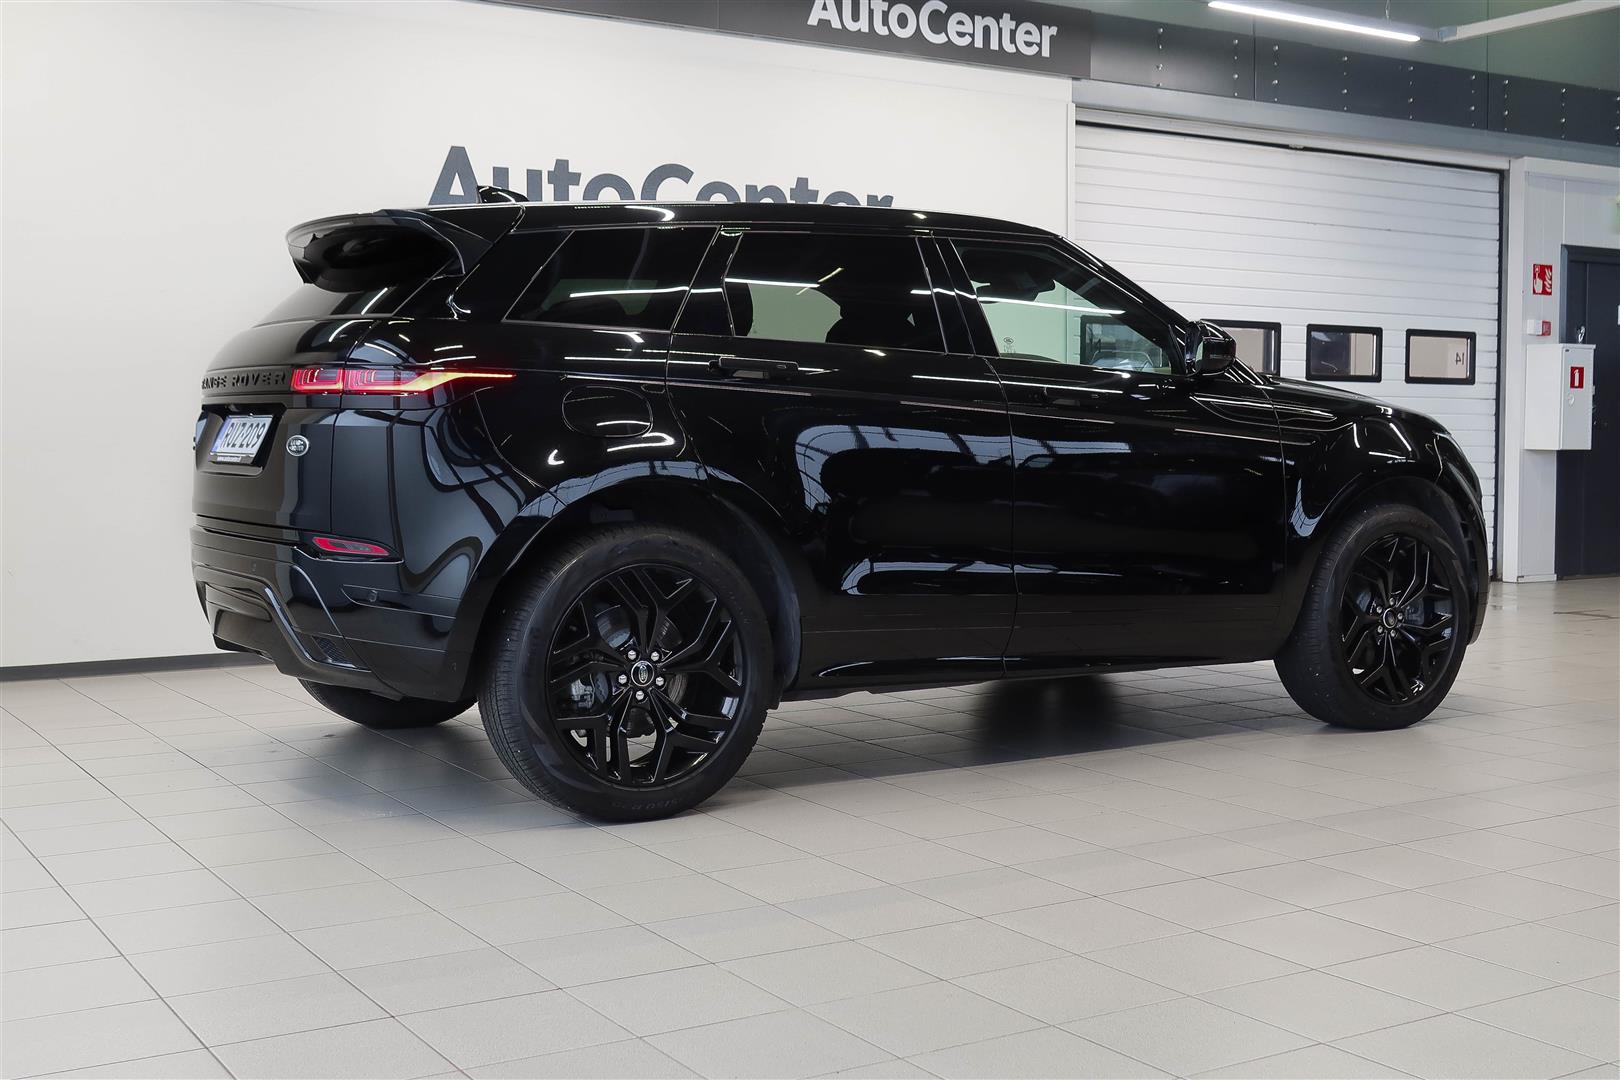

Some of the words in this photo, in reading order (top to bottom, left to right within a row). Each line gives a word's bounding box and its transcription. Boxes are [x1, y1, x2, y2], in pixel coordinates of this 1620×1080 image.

[806, 0, 1058, 58] AutoCenter
[428, 145, 894, 207] AutoC
[231, 372, 286, 387] ROVER
